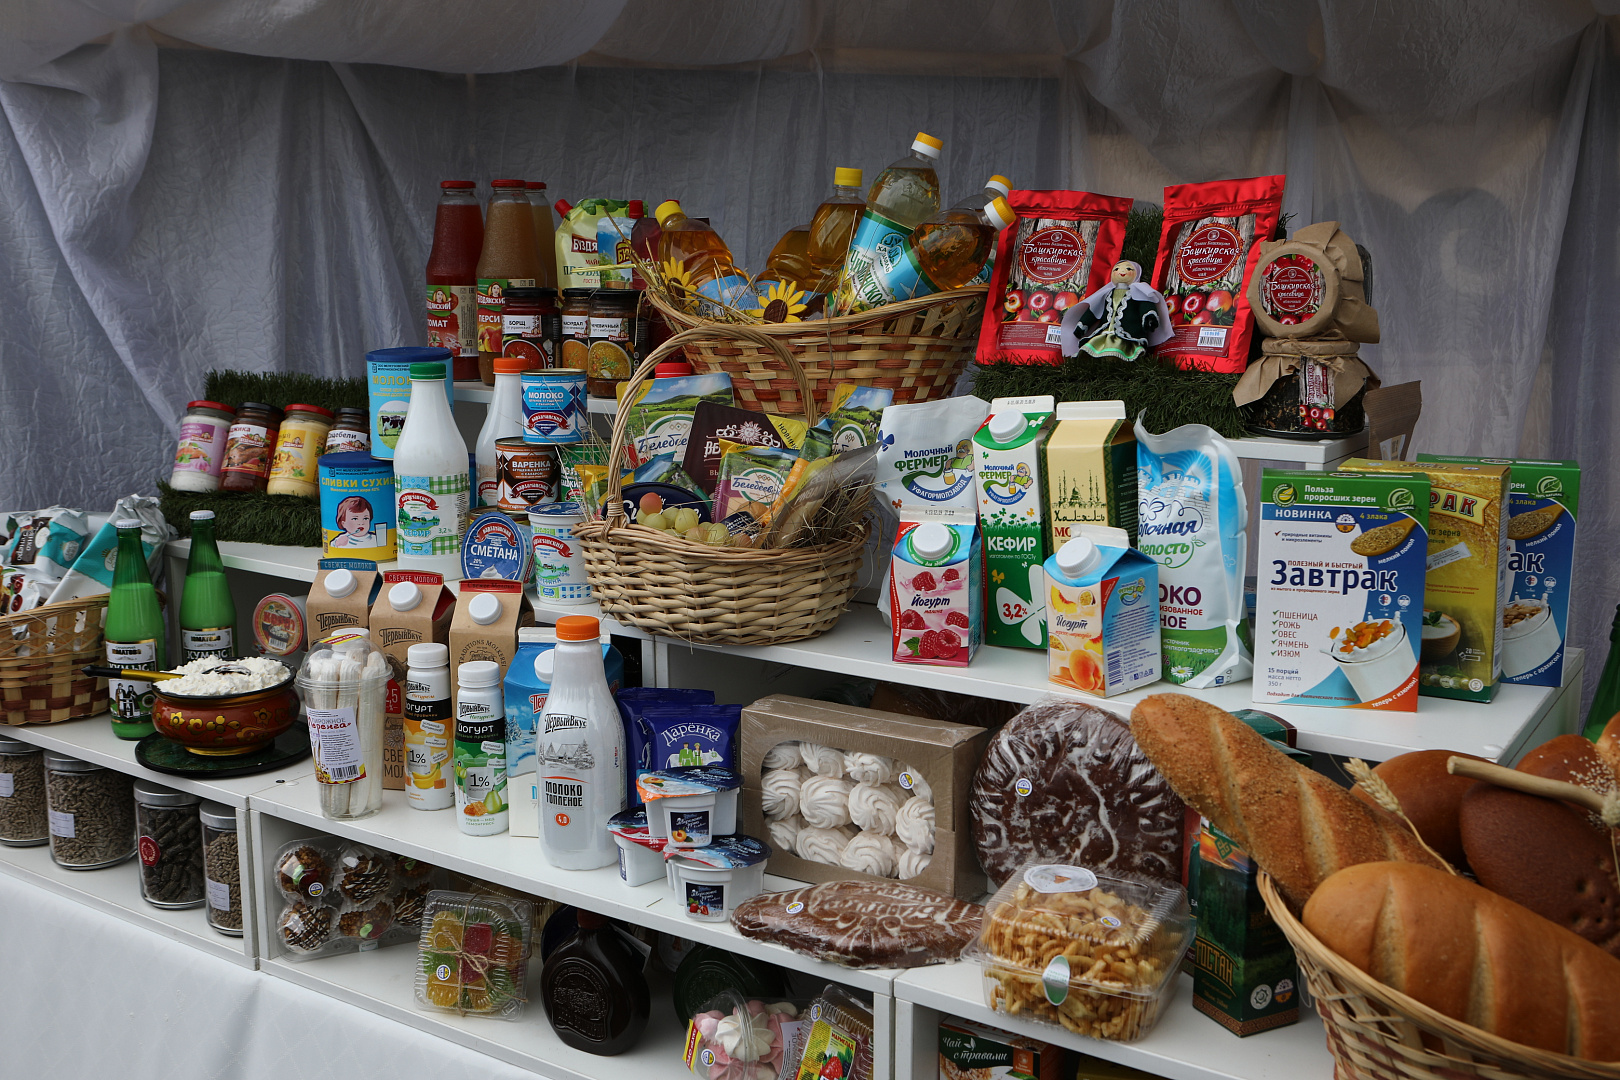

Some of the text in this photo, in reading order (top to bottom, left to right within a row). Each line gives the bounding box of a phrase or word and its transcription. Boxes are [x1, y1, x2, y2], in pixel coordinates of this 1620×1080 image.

[1023, 243, 1084, 257] Башкирская
[1181, 246, 1240, 257] Башкирская
[1031, 255, 1067, 266] красавица
[1188, 255, 1223, 266] красавица
[1269, 281, 1315, 290] Башкирская
[528, 391, 564, 399] МОЛОКО
[904, 444, 953, 459] Молочный
[894, 454, 948, 472] ФЕРМЕР
[984, 464, 1015, 472] Молочный
[979, 471, 1012, 480] ФЕРМЕР
[322, 477, 395, 487] СЛИВКИ СУХИЕ
[1304, 485, 1334, 493] Польза
[1304, 494, 1350, 503] проросших
[1275, 508, 1332, 520] НОВИНКА
[987, 536, 1037, 552] КЕФИР
[470, 544, 518, 561] СМЕТАНА
[1288, 560, 1323, 568] ПОЛЕЗНЫЙ
[389, 574, 438, 583] СВЕЖЕЕ МОЛОКО
[1271, 560, 1399, 595] Завтрак
[911, 594, 950, 609] Йогурт
[1279, 612, 1318, 621] ПШЕНИЦА
[1056, 614, 1088, 631] Йогурт
[1278, 621, 1301, 629] РОЖЬ
[1278, 640, 1309, 649] ЯЧМЕНЬ
[1277, 649, 1300, 658] ИЗЮМ
[1371, 698, 1392, 709] теперь
[1397, 677, 1418, 697] изюмом!
[660, 722, 723, 747] Дарёнка
[470, 773, 490, 787] 1%
[546, 781, 583, 797] МОЛОКО
[546, 792, 583, 807] ТОПЛЕНОЕ
[943, 1036, 962, 1048] Чай
[960, 1050, 1008, 1063] травами
